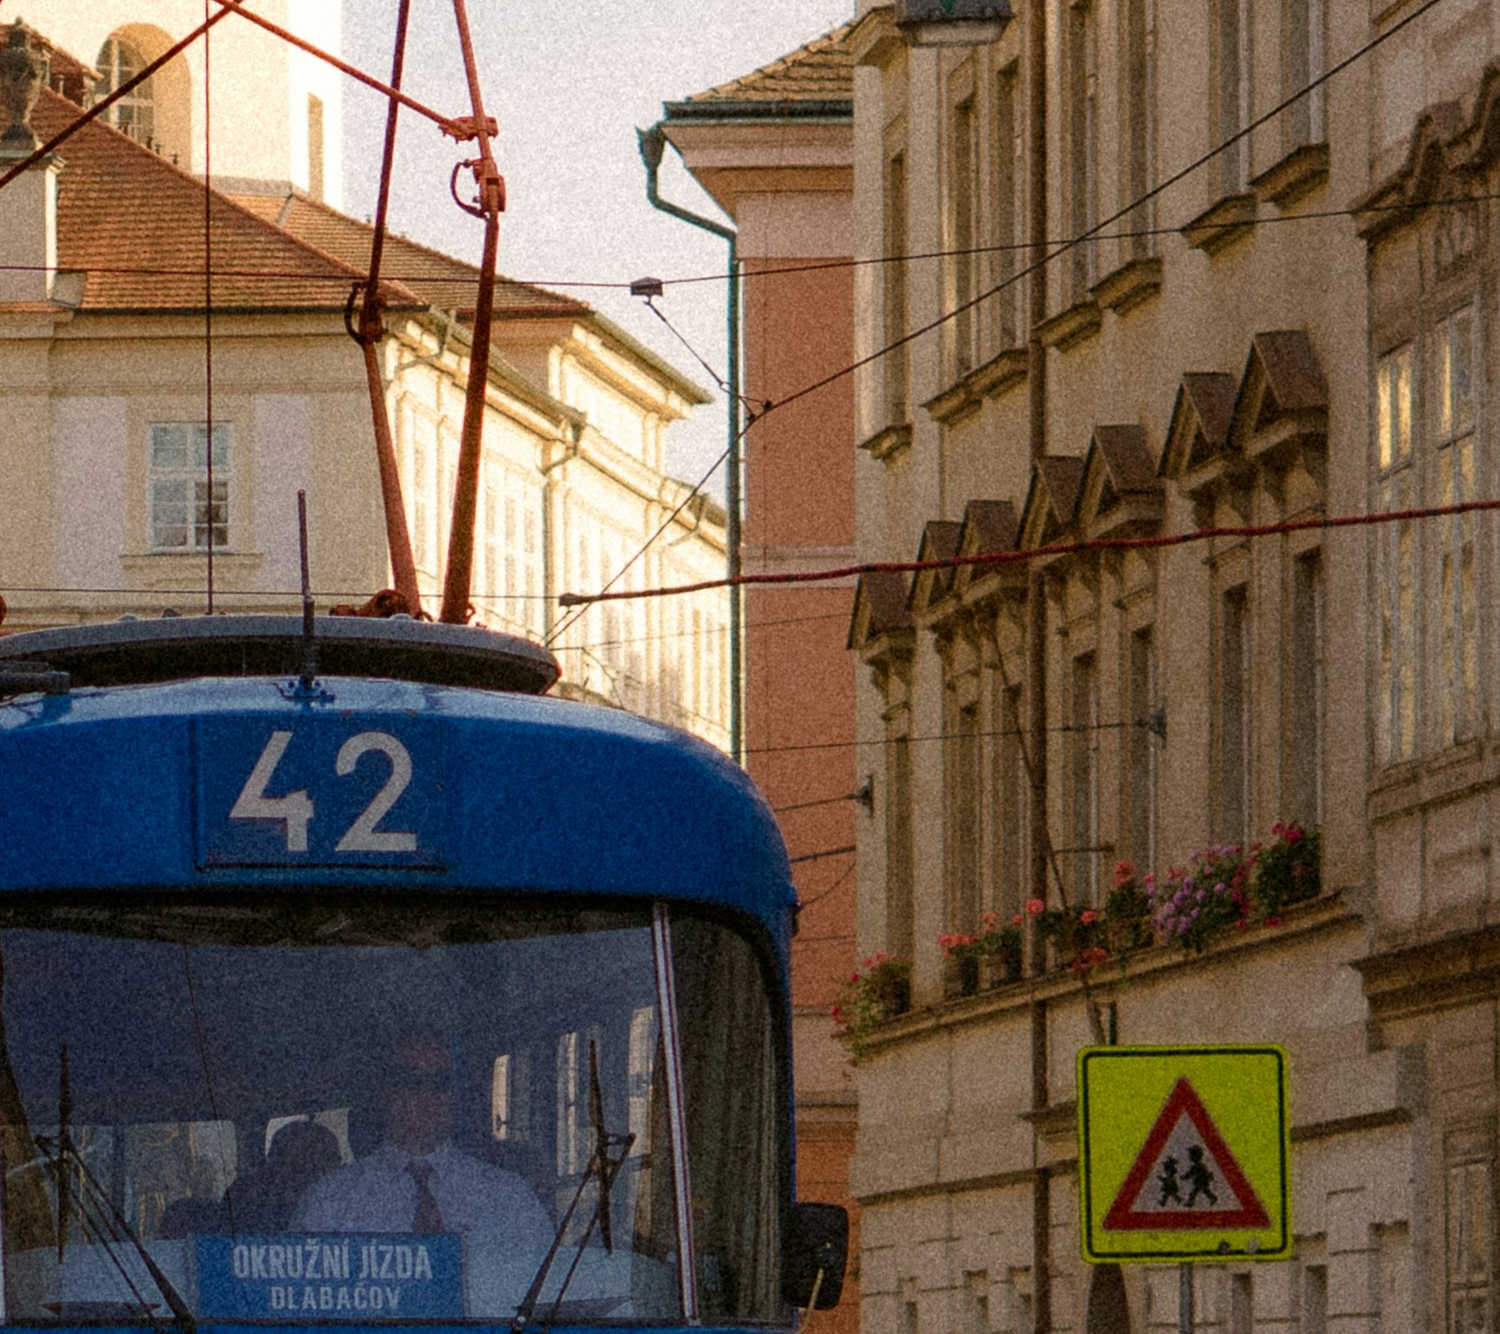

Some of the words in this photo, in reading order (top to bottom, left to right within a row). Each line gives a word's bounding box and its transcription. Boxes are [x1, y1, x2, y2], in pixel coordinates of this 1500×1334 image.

[228, 729, 418, 855] 42
[232, 1237, 351, 1280] OKRUŽNÍ
[358, 1238, 434, 1280] JÍZDA
[270, 1281, 402, 1311] DLABAČOV
